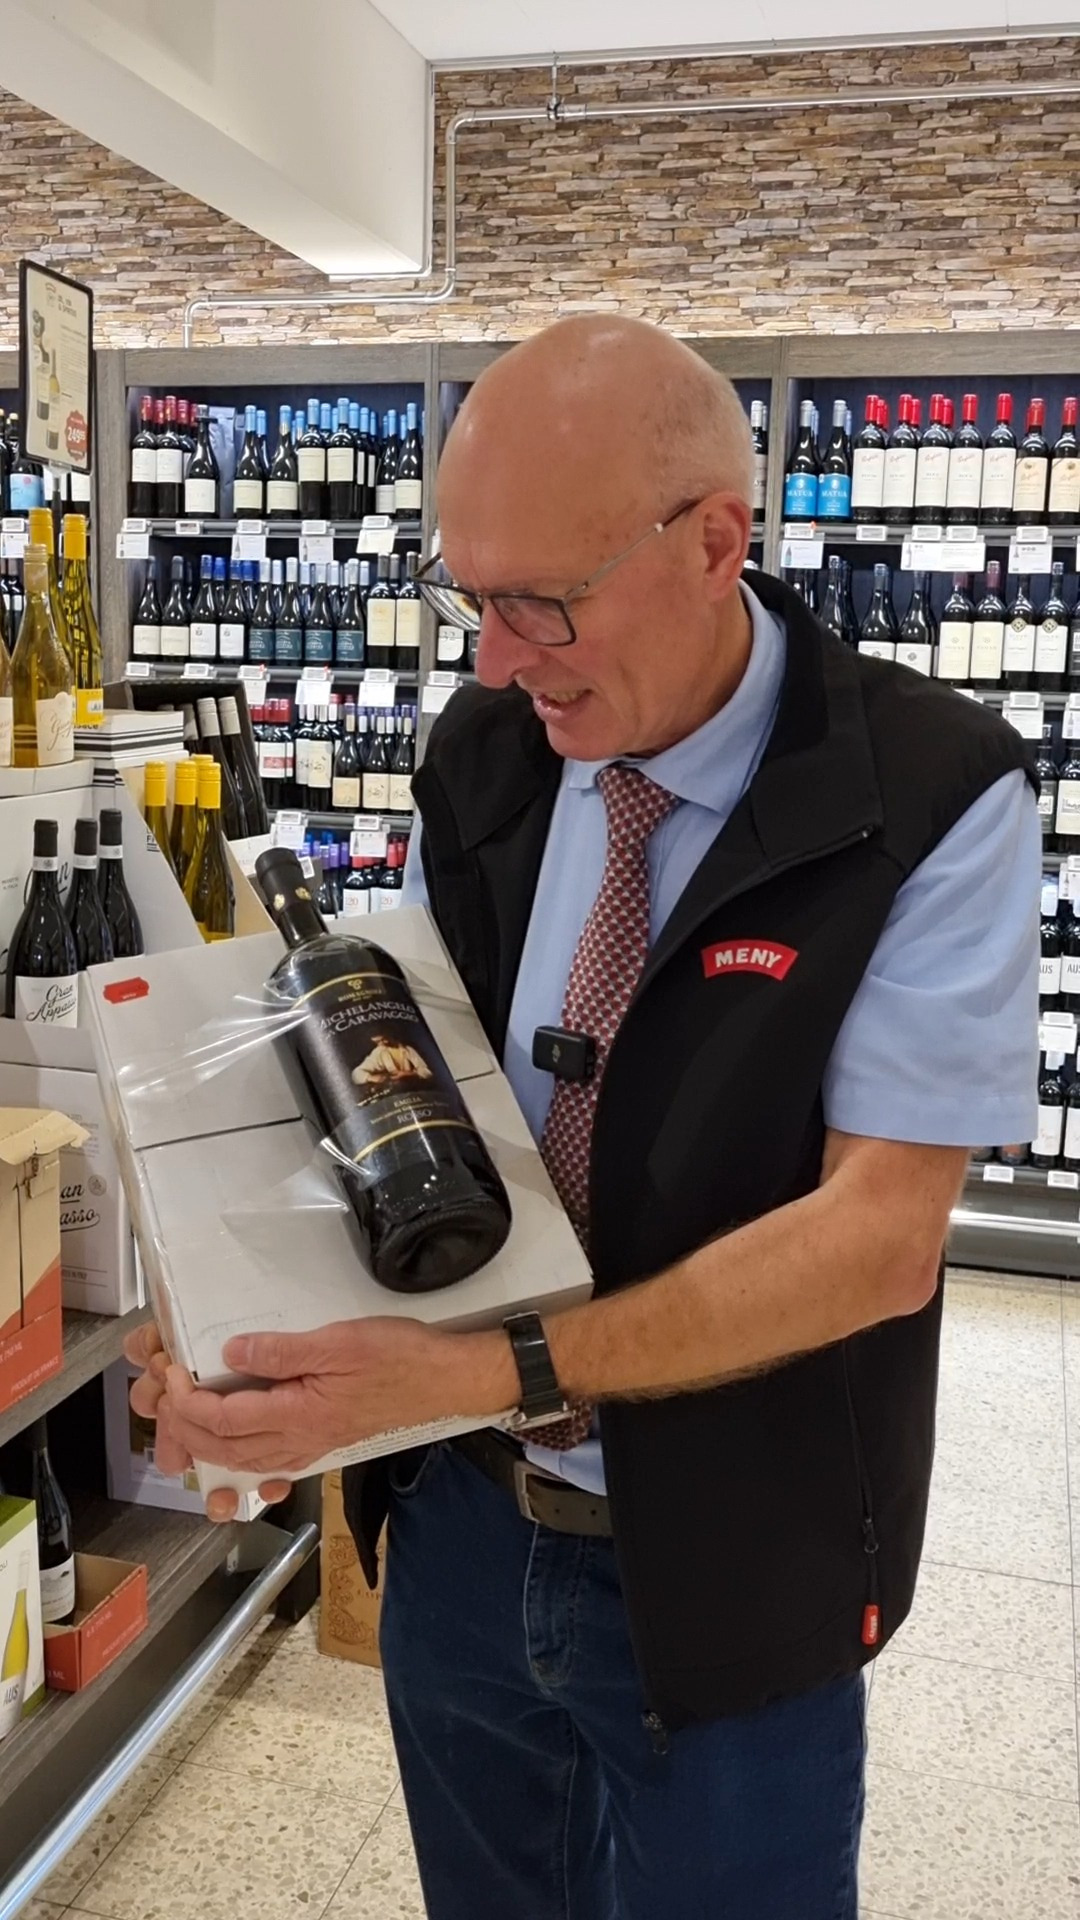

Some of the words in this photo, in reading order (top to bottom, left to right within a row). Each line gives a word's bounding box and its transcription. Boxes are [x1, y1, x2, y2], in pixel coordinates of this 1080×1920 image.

[787, 489, 813, 497] MATUA
[821, 489, 848, 498] MATUA
[714, 947, 783, 969] MENY
[320, 1000, 416, 1030] MICHELANGELO
[334, 1010, 419, 1032] CARAVAGGIO
[396, 1108, 432, 1124] ROSSO
